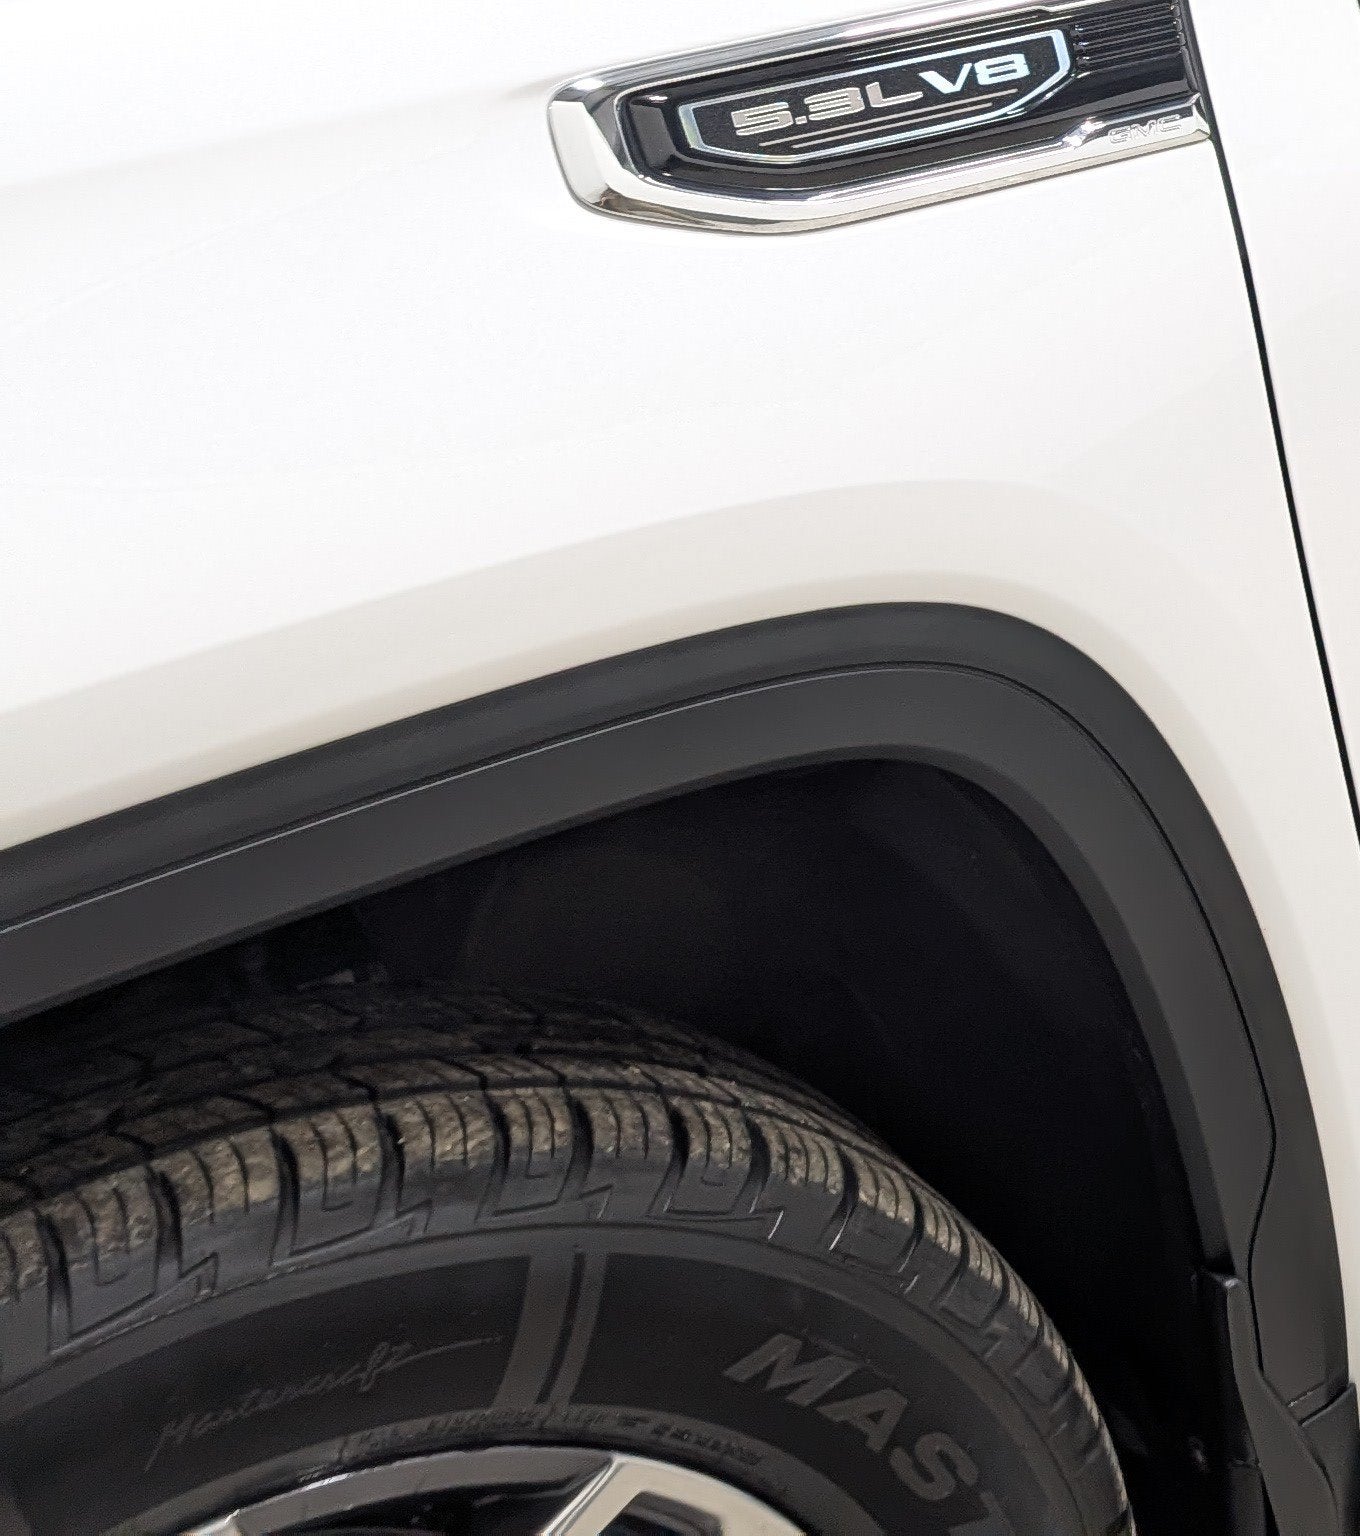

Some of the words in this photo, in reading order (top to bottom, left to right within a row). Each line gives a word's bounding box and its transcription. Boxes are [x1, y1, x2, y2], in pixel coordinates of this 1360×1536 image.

[731, 82, 923, 137] 5.3L
[918, 53, 1029, 95] V8
[1108, 114, 1181, 143] GMC
